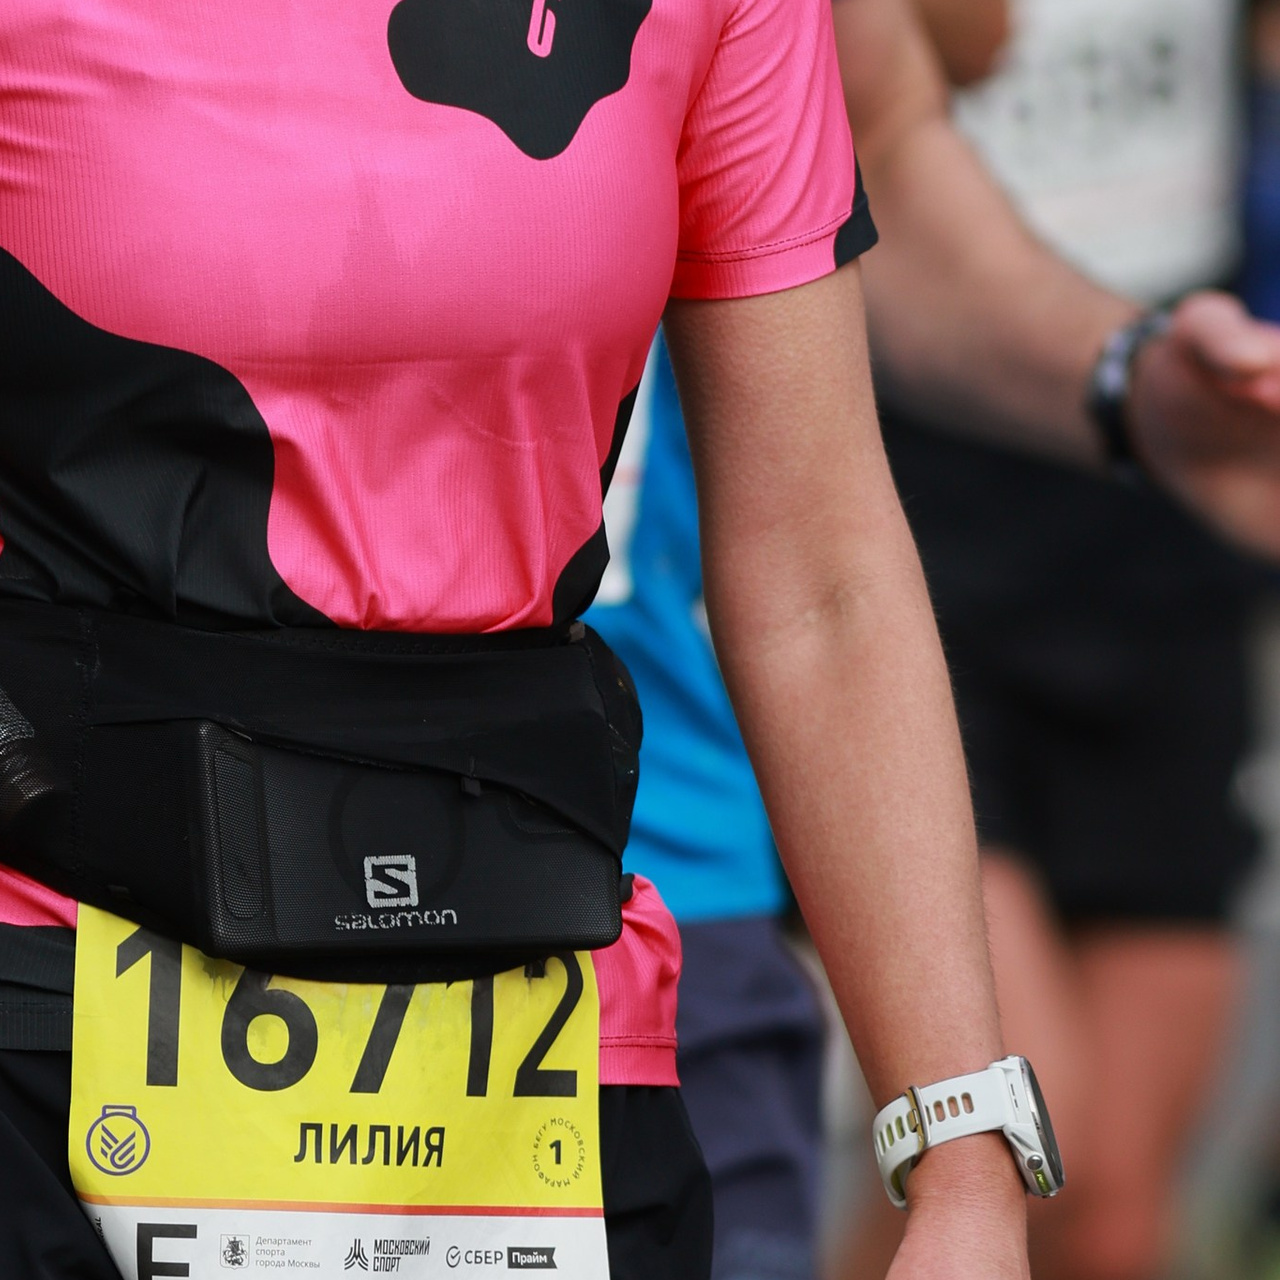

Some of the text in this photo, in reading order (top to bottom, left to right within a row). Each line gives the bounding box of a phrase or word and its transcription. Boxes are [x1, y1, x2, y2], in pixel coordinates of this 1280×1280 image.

[116, 926, 583, 1098] 16712
[294, 1122, 445, 1167] ЛИЛИЯ
[549, 1139, 562, 1165] 1
[255, 1236, 312, 1247] Департамент
[373, 1236, 431, 1256] МОСКОВСКИЙ
[255, 1248, 286, 1257] спорта
[464, 1250, 548, 1266] СБЕР Прайм
[255, 1259, 321, 1269] города Москвы
[373, 1256, 401, 1272] СПОРТ
